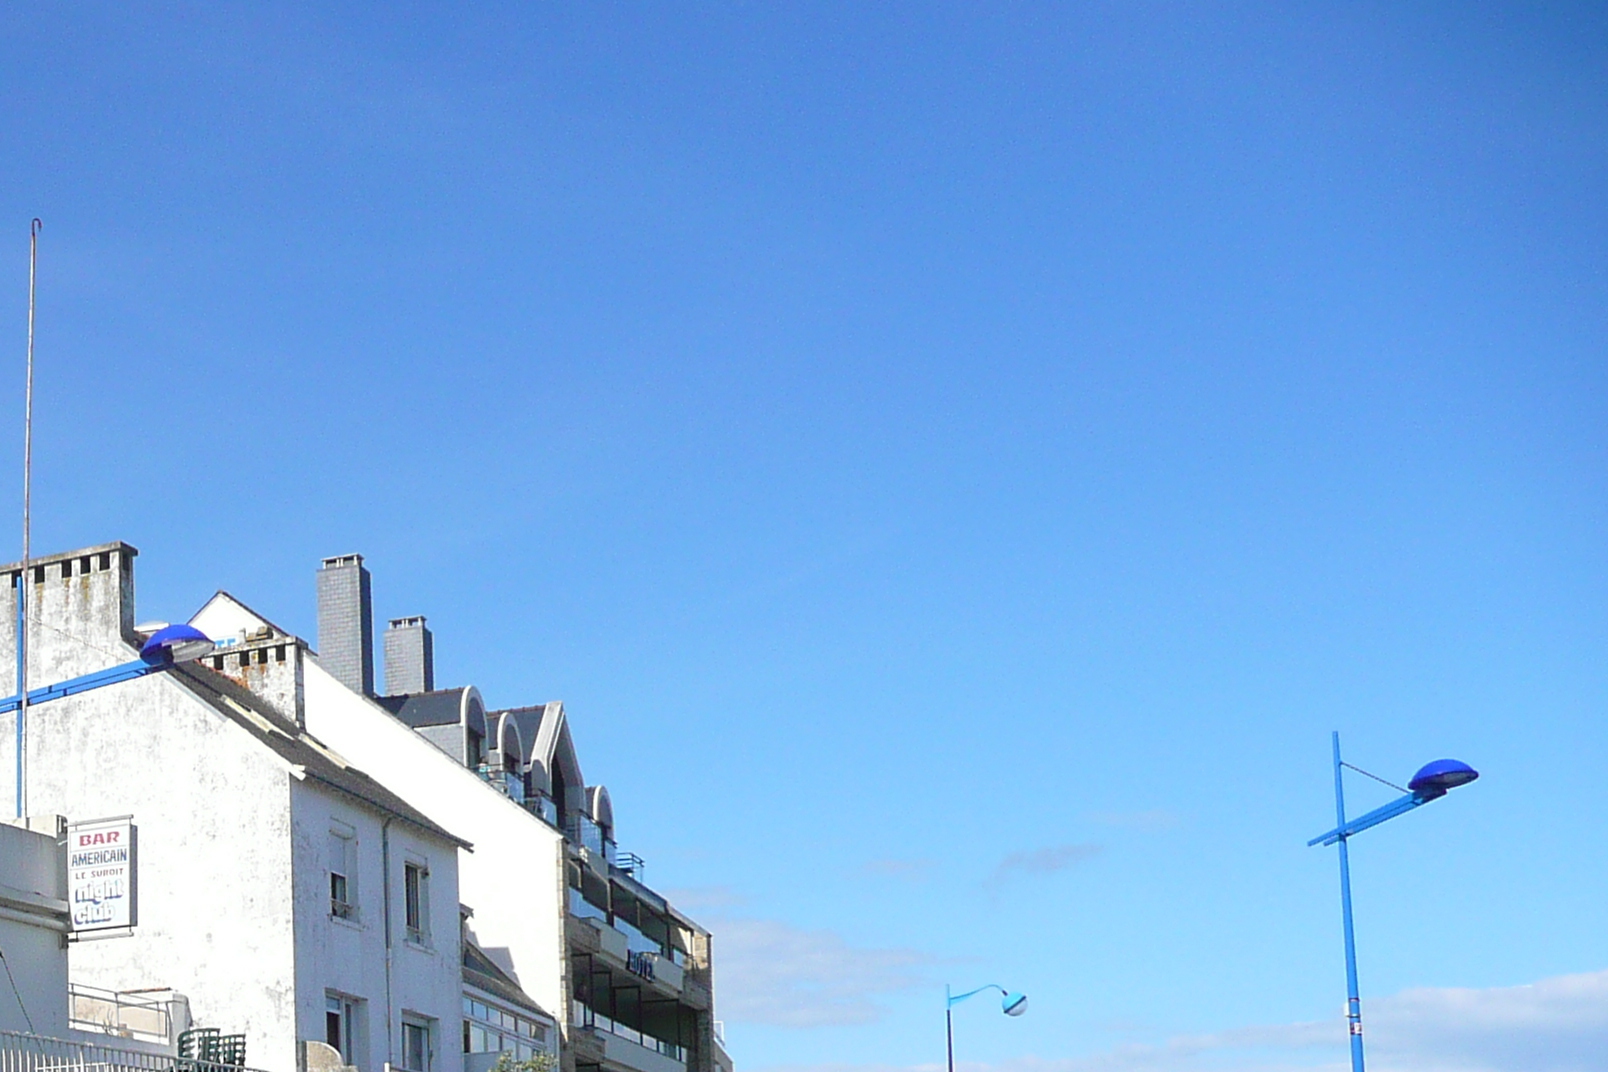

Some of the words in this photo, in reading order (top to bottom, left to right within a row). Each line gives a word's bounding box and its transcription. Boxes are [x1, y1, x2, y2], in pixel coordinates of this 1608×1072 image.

[79, 831, 120, 847] BAR
[71, 848, 127, 868] AMERICAIN
[75, 871, 87, 880] LE
